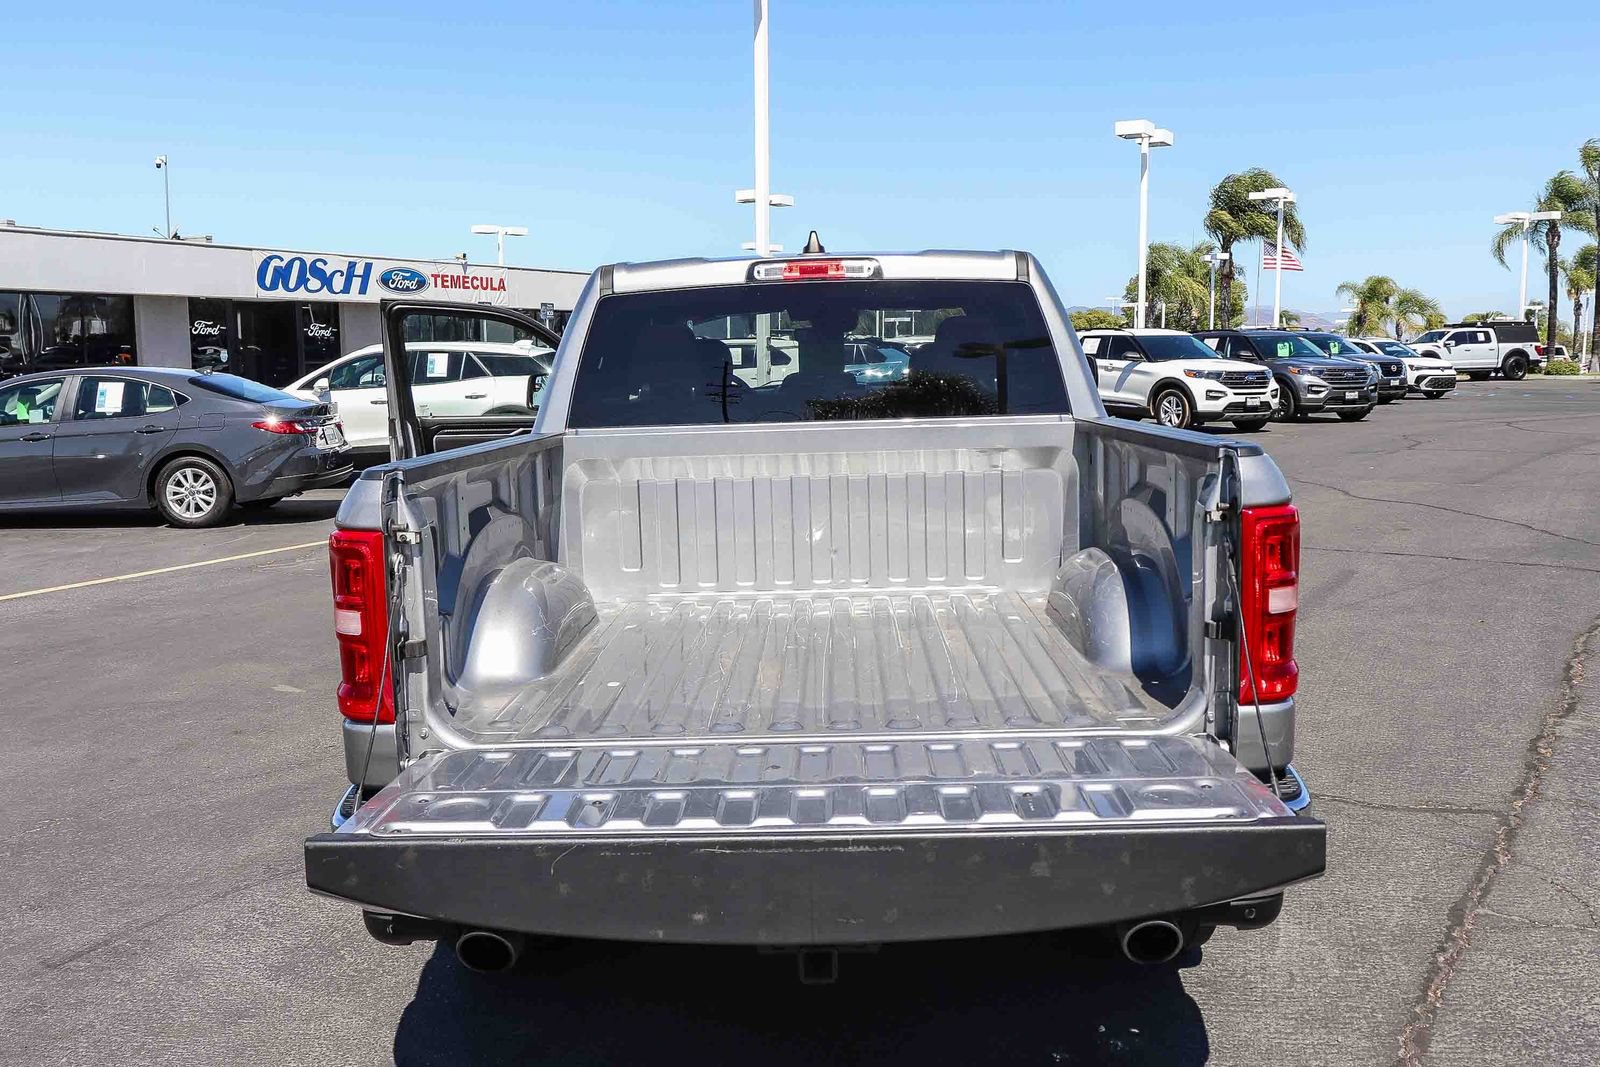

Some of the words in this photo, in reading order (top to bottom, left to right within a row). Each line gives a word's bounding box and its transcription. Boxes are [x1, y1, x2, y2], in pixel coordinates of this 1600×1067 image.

[388, 270, 419, 290] Ford
[431, 273, 506, 292] TEMECULA
[191, 319, 221, 336] Ford
[307, 322, 332, 337] Ford
